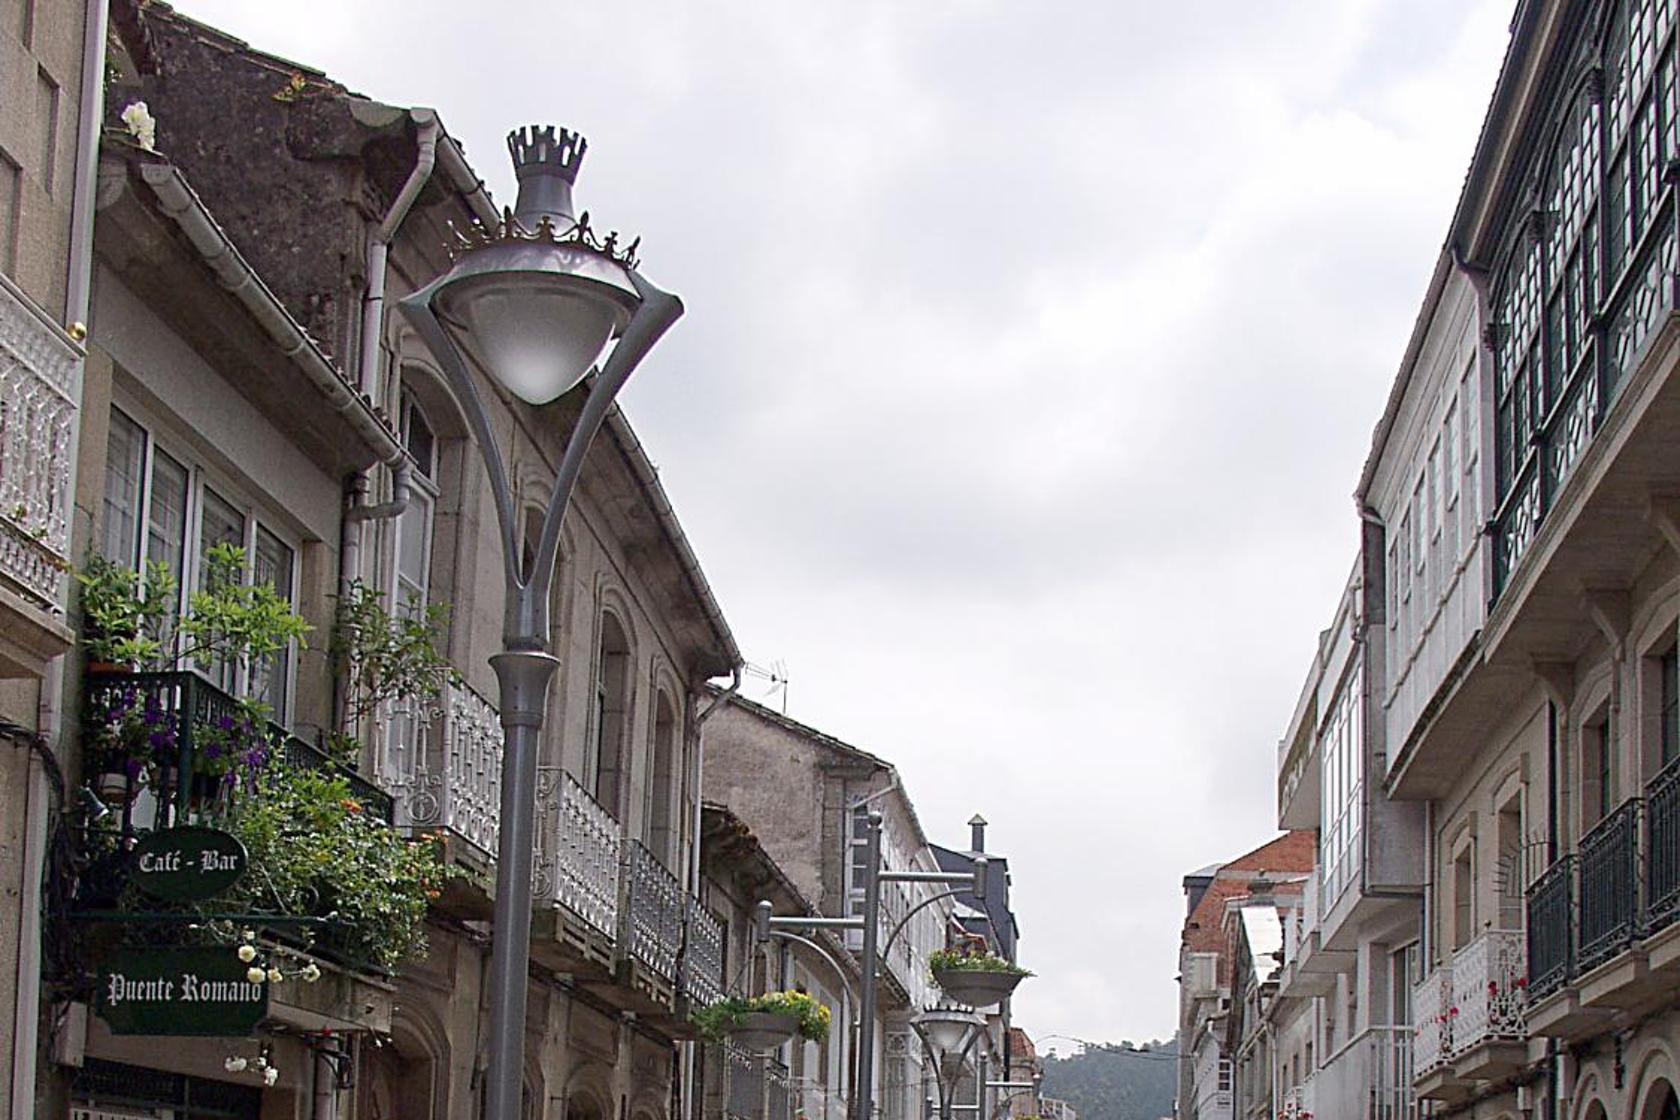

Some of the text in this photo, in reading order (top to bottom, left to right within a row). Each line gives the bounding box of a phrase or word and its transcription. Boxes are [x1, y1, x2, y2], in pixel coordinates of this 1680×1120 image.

[139, 850, 181, 872] Café
[200, 849, 238, 874] Bar
[107, 973, 262, 1006] Puente Romano
